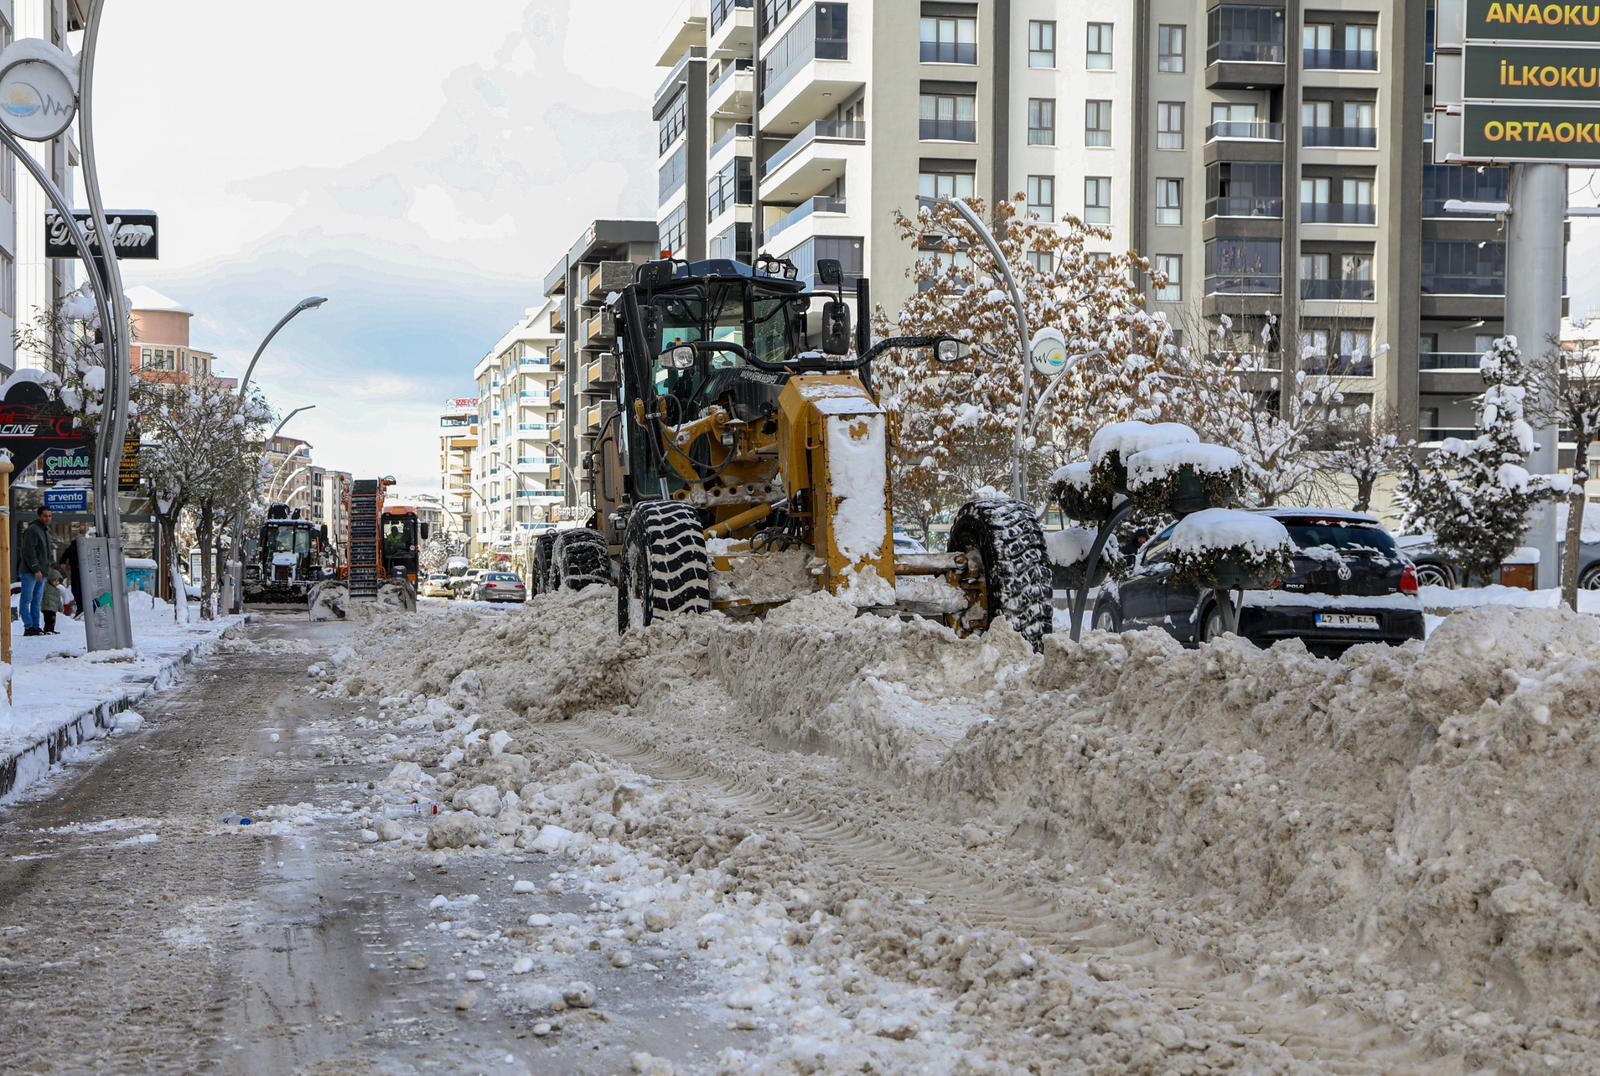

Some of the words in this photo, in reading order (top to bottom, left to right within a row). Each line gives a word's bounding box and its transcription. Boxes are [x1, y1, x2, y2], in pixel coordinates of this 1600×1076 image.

[1486, 2, 1600, 25] ANAOKU
[1500, 59, 1600, 88] İLKOKU
[0, 424, 39, 434] CING
[47, 493, 83, 501] arvento
